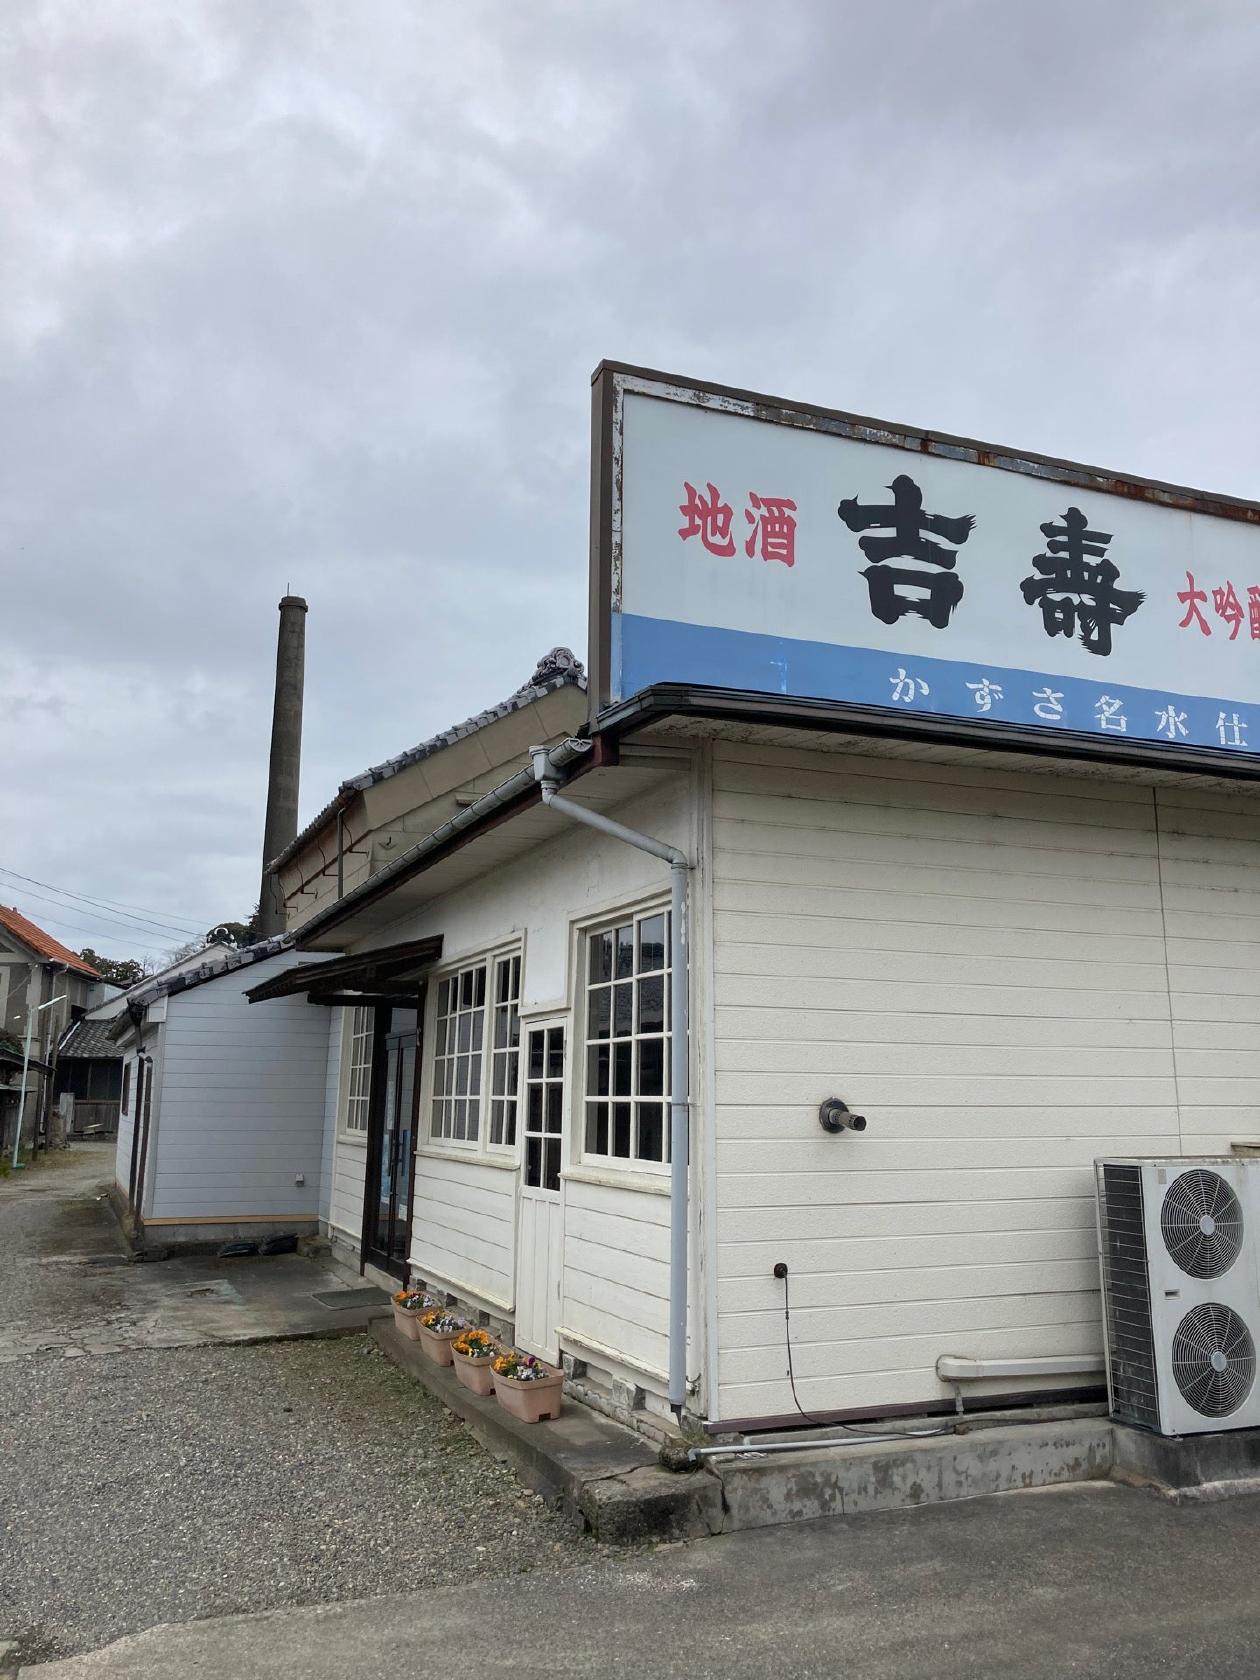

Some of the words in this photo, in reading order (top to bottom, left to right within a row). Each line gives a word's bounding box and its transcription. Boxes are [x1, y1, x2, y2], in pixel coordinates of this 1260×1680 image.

[678, 481, 798, 568] 地酒
[888, 668, 1249, 747] かずさ名水仕
